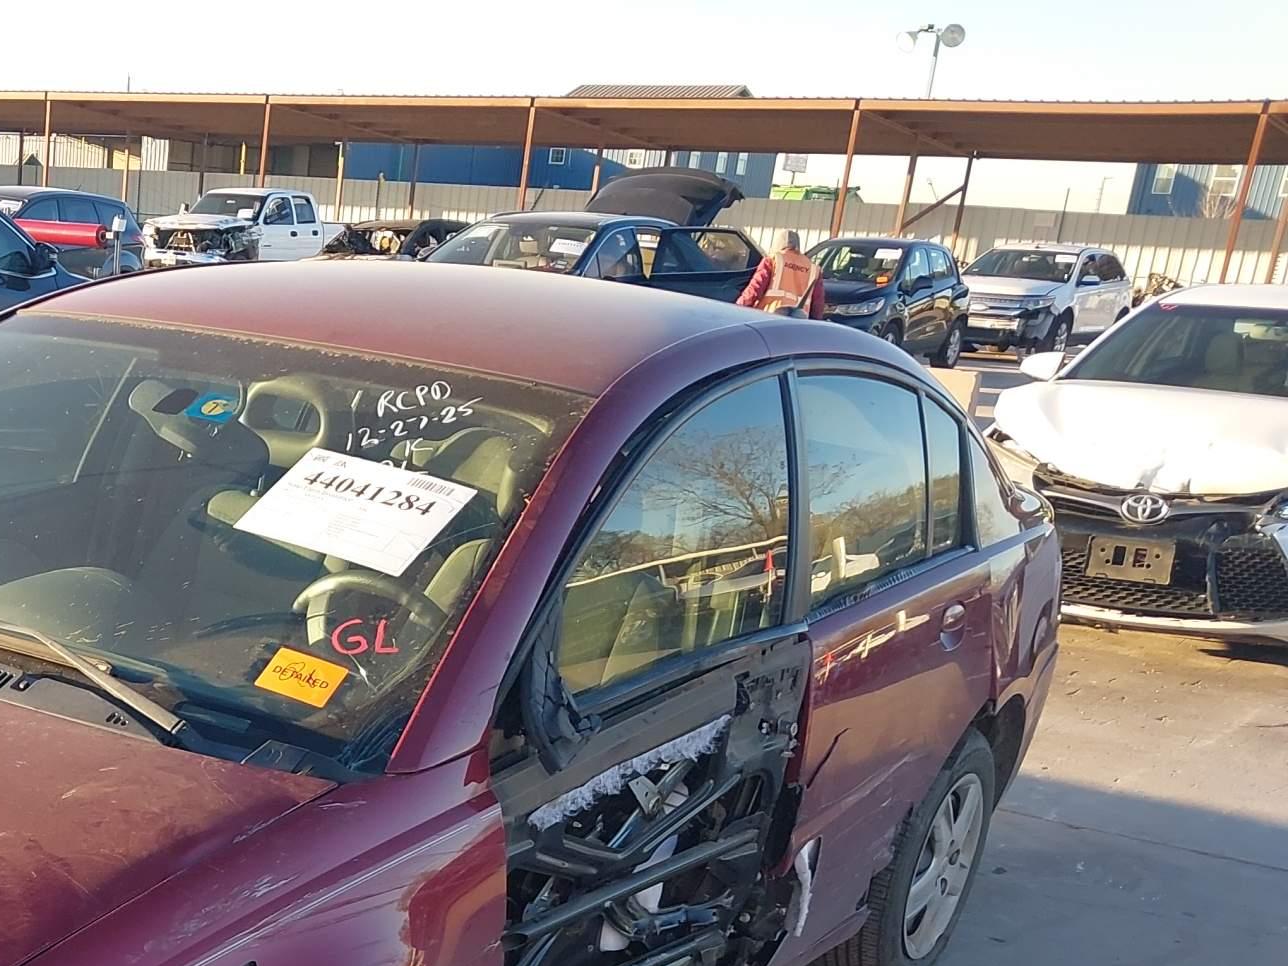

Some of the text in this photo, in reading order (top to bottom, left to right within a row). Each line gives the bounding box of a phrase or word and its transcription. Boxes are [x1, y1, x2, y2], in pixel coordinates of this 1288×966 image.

[784, 262, 810, 273] AGENCY
[304, 471, 437, 516] 44041284
[331, 618, 399, 655] GL
